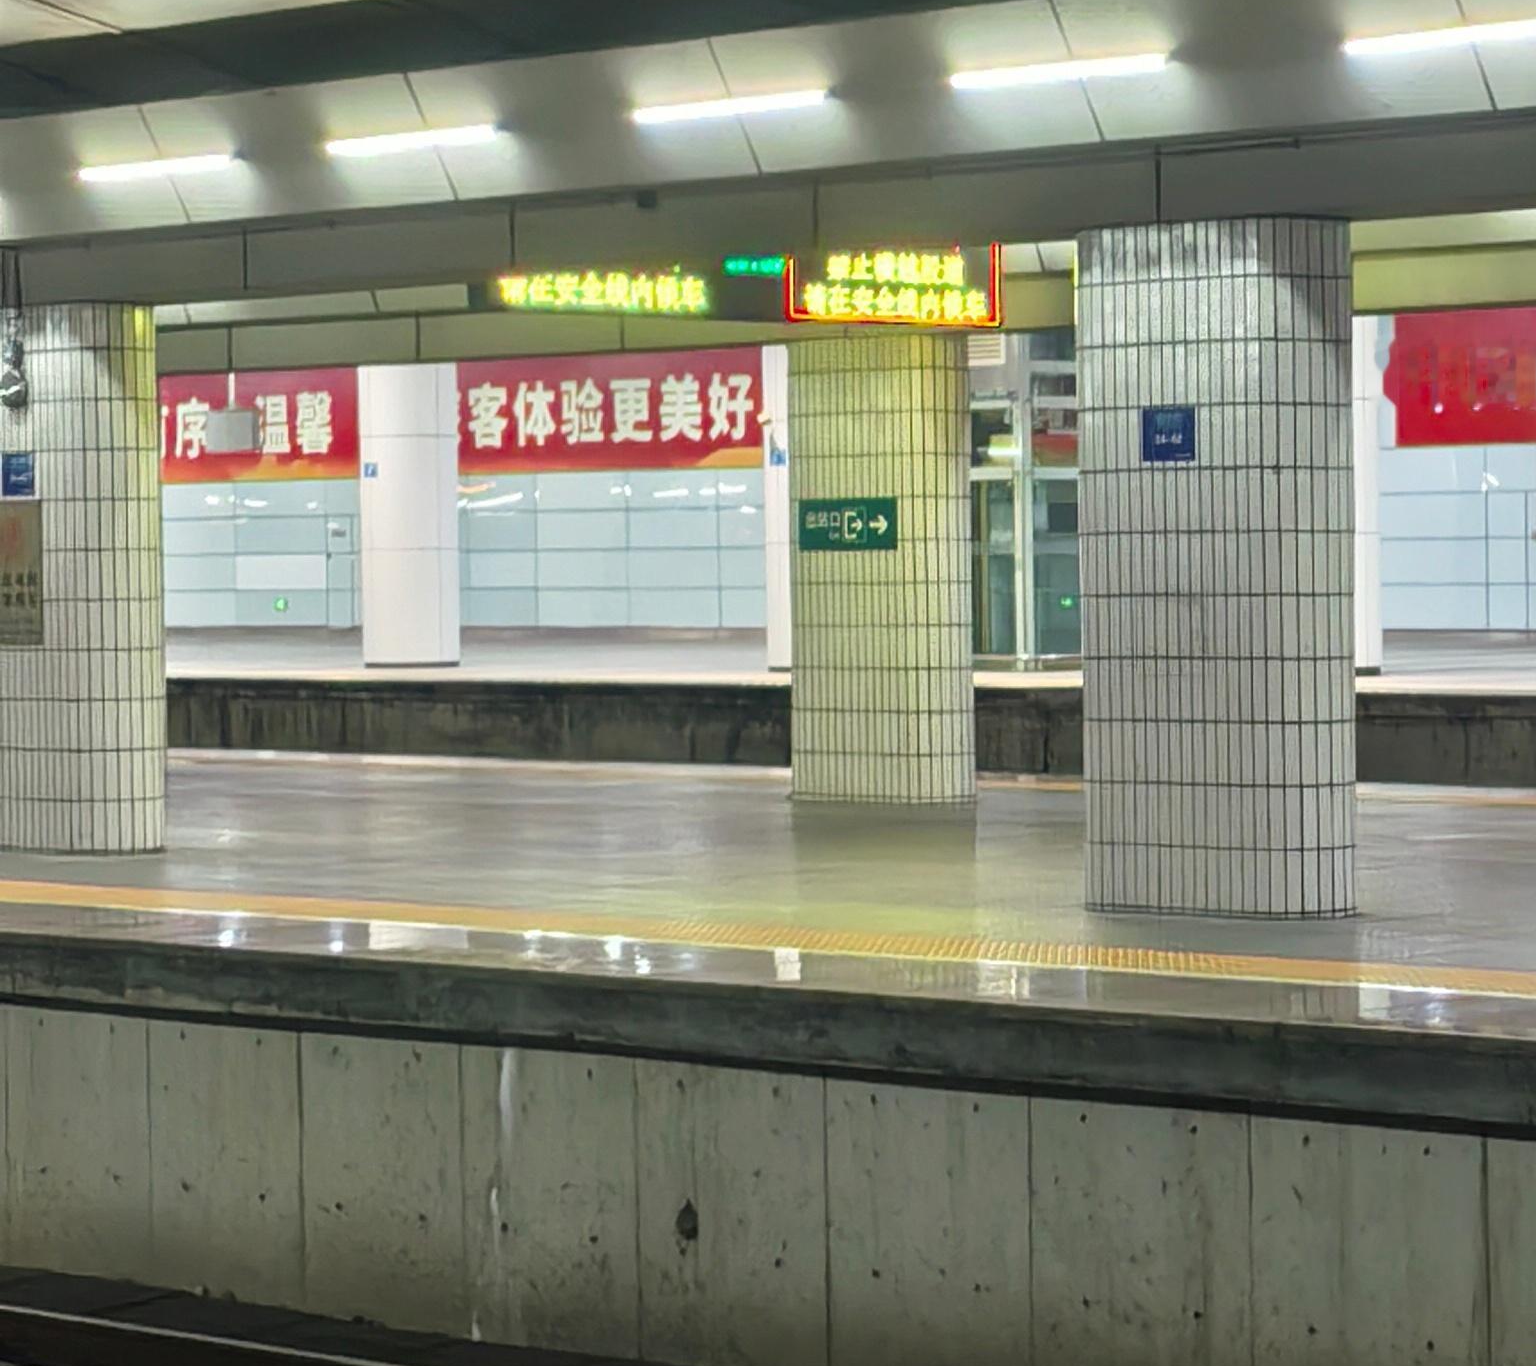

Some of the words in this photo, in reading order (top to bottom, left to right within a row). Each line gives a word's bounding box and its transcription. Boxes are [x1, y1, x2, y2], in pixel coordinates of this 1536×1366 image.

[457, 372, 754, 449] 客体验更美好
